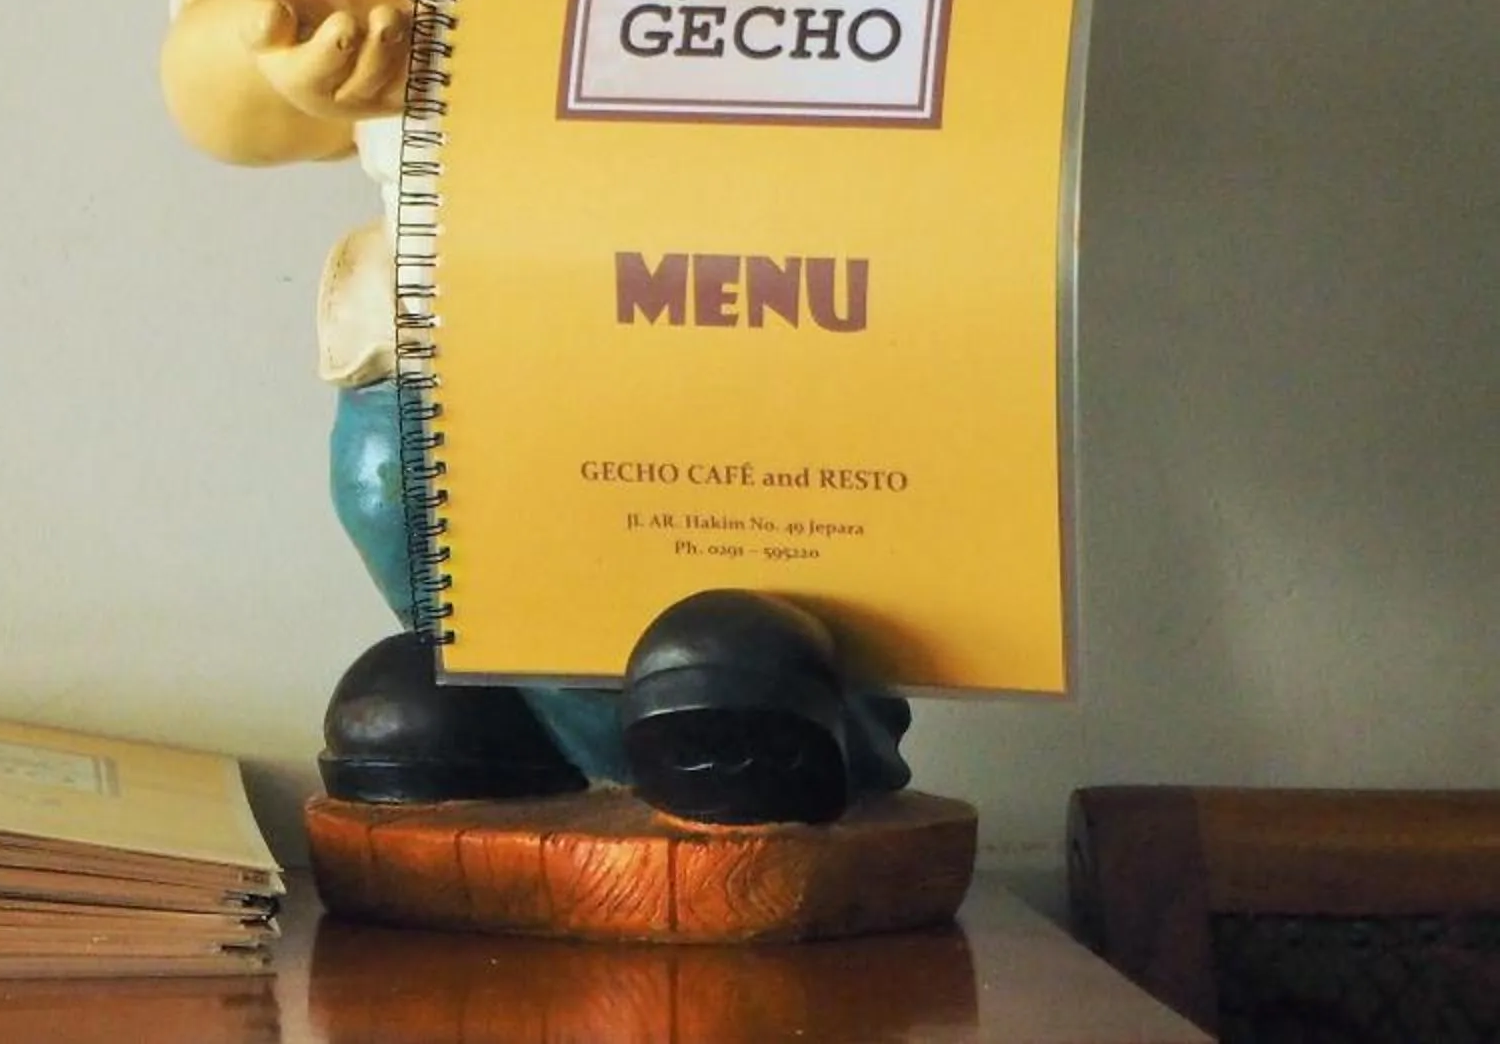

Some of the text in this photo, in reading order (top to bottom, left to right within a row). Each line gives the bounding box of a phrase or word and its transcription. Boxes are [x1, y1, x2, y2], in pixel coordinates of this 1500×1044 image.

[619, 3, 902, 62] GECHO
[615, 251, 869, 333] MENU
[580, 461, 908, 492] GECHO CAFÉ and RESTO
[685, 515, 746, 531] Hakim
[808, 520, 864, 538] Jepara
